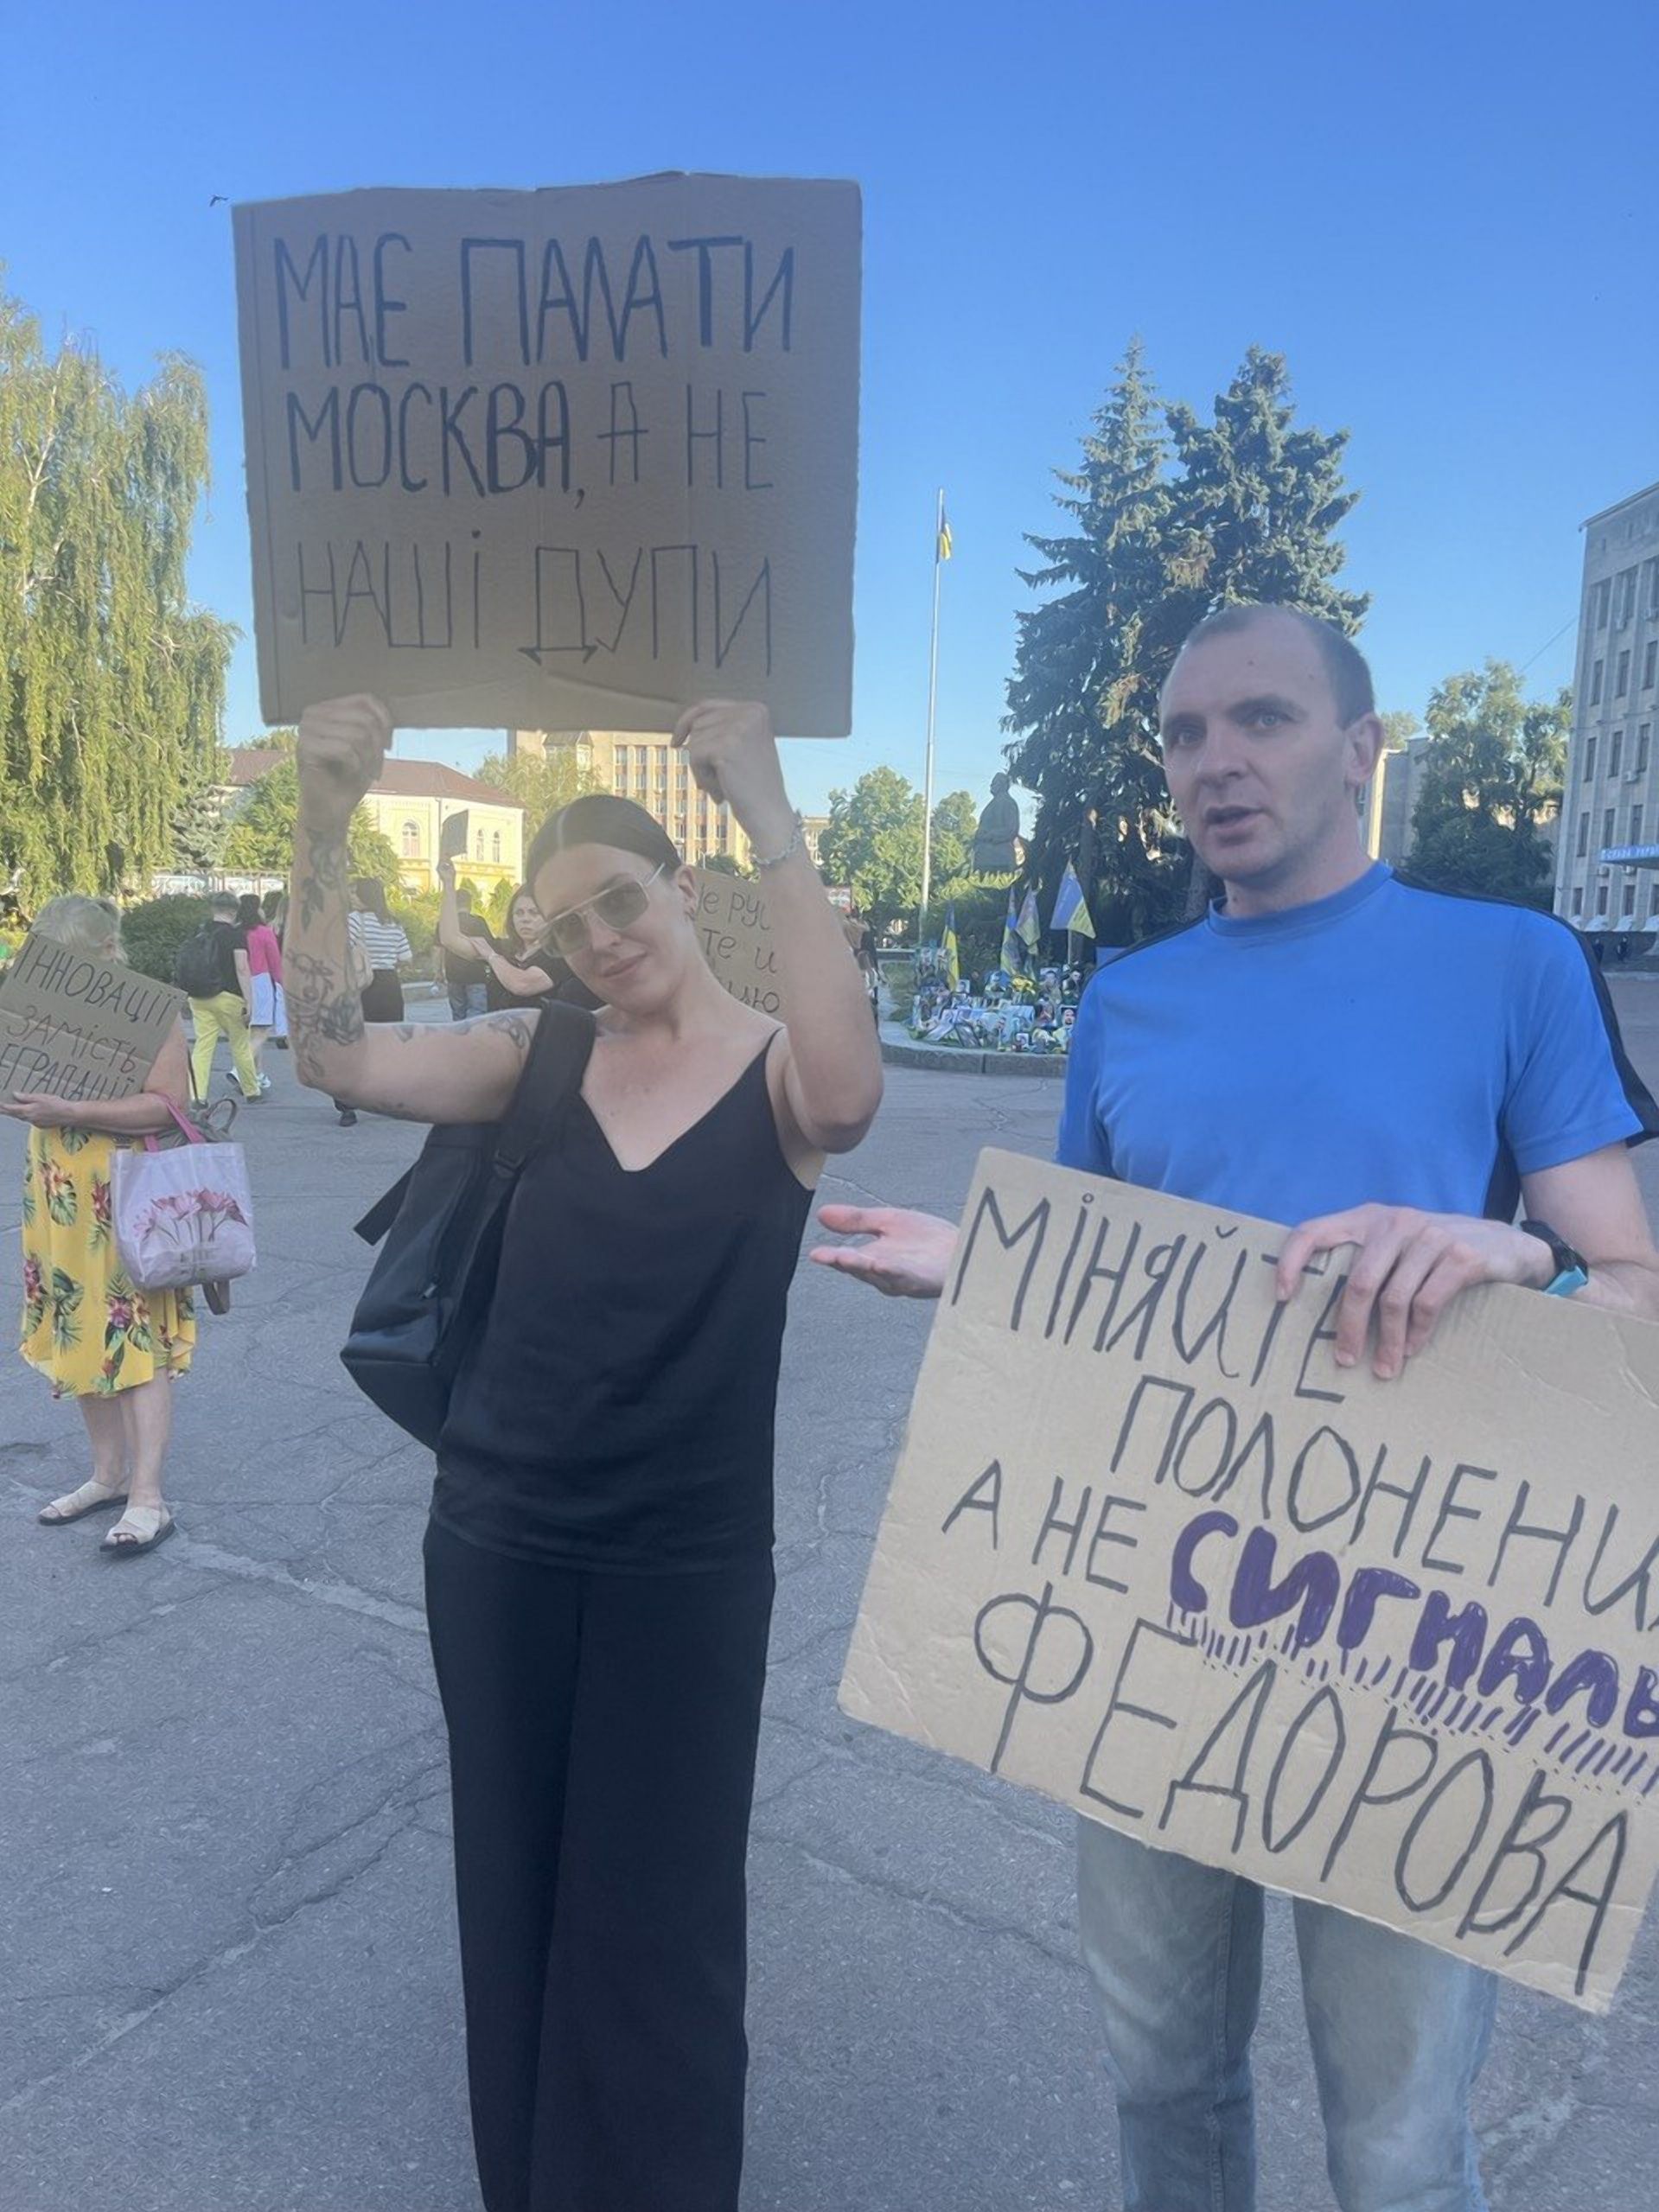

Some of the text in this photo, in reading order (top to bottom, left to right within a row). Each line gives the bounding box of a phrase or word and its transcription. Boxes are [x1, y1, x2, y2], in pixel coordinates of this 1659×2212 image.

[273, 233, 794, 370] МАЄ ПАЛАТИ
[286, 381, 774, 509] МОСКВА, А НЕ
[298, 529, 772, 677] НАШІ ДУПИ
[7, 1004, 137, 1074] ЗАМІСТЬ
[14, 936, 178, 1027] ІННОВАЦІЇ
[951, 1186, 1349, 1404] МІНЯЙТЕ
[941, 1458, 1002, 1551] А
[1031, 1476, 1147, 1595] НЕ
[1109, 1374, 1659, 1633] ПОЛОНЕНИ
[973, 1580, 1629, 1996] ФЕДОРОВА
